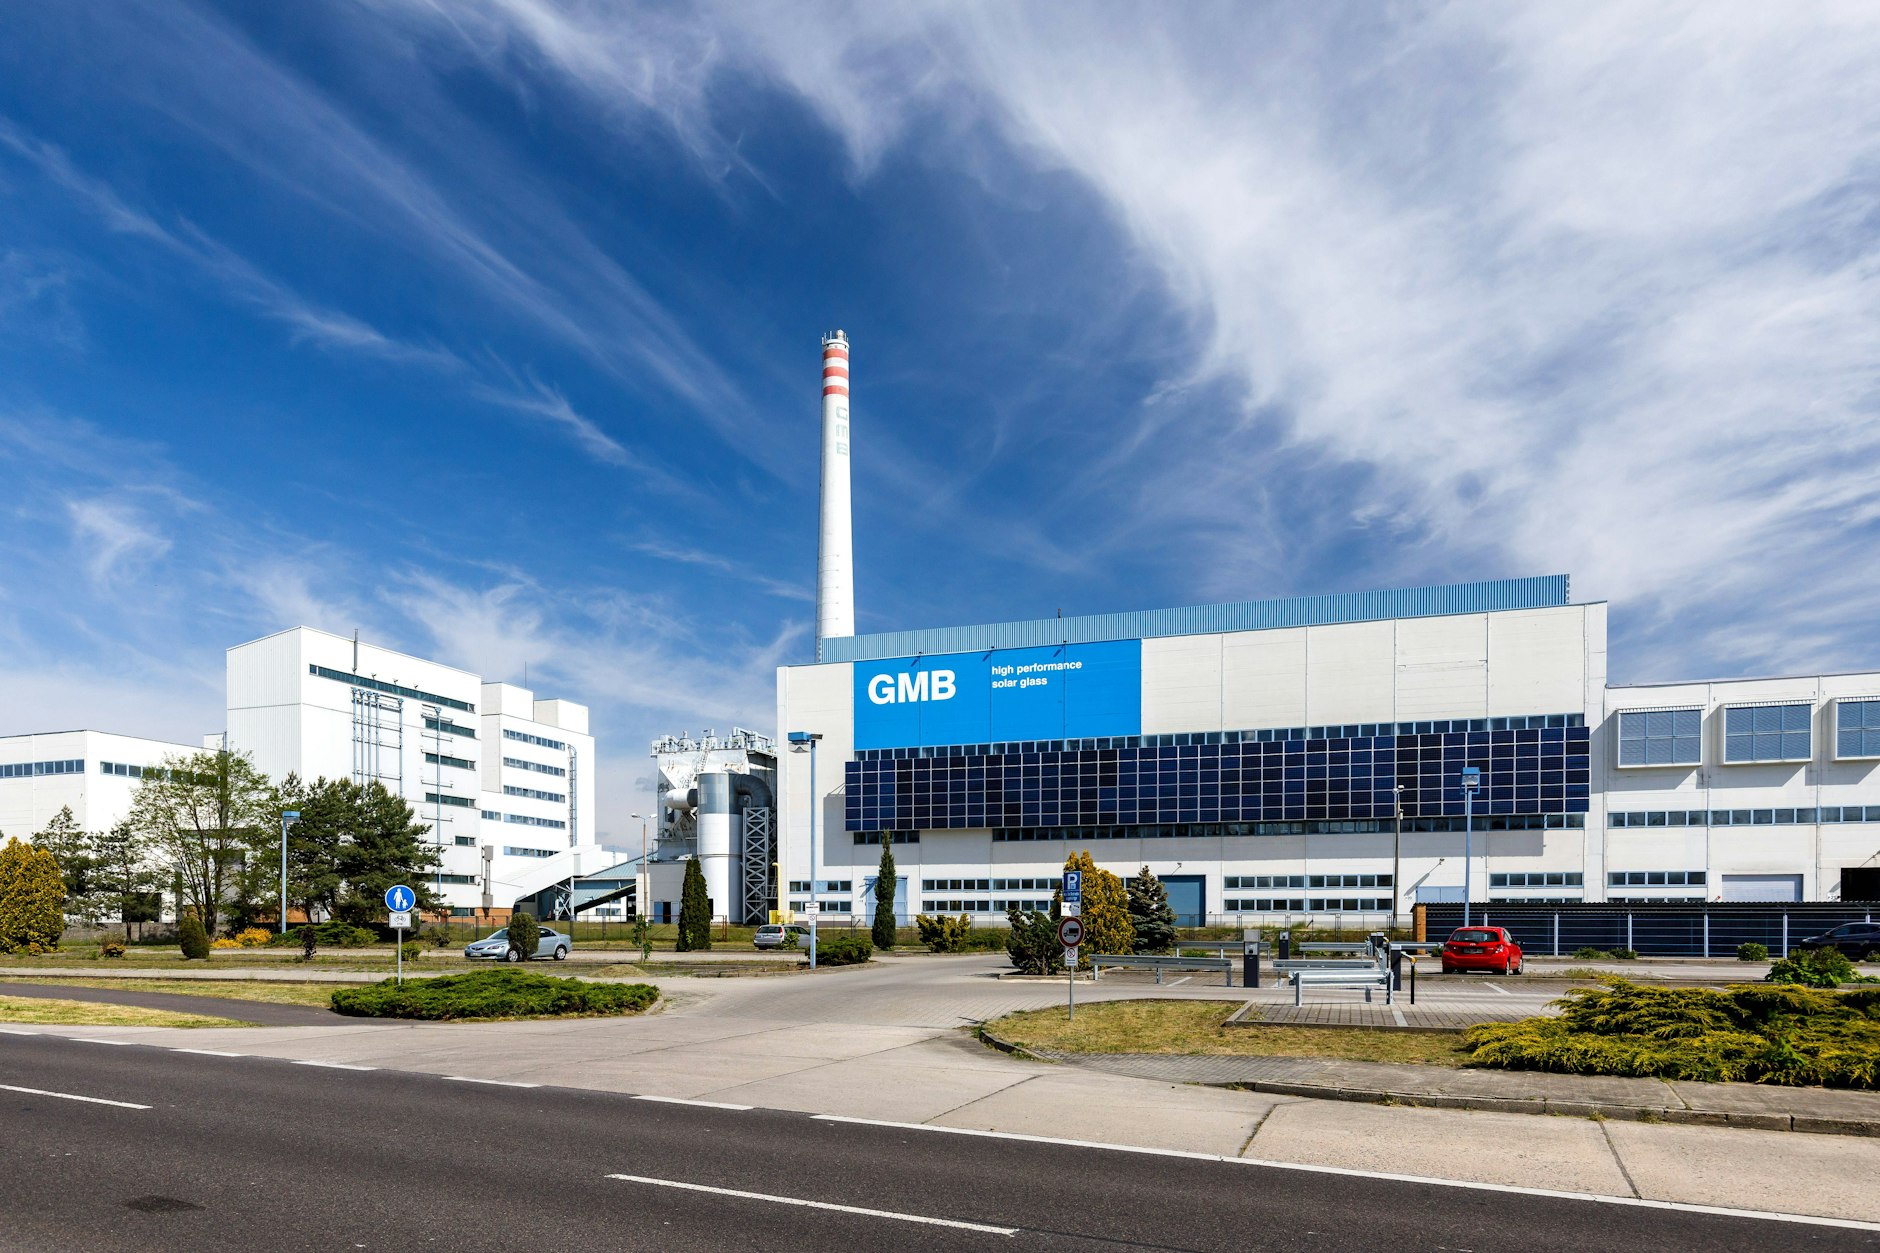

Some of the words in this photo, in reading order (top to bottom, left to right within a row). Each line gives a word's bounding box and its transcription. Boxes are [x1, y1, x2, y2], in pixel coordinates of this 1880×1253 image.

[991, 664, 1015, 677] high
[1016, 661, 1083, 676] performance
[867, 669, 957, 705] GMB
[991, 678, 1018, 689] solar
[1020, 676, 1048, 689] glass
[1067, 873, 1078, 890] P
